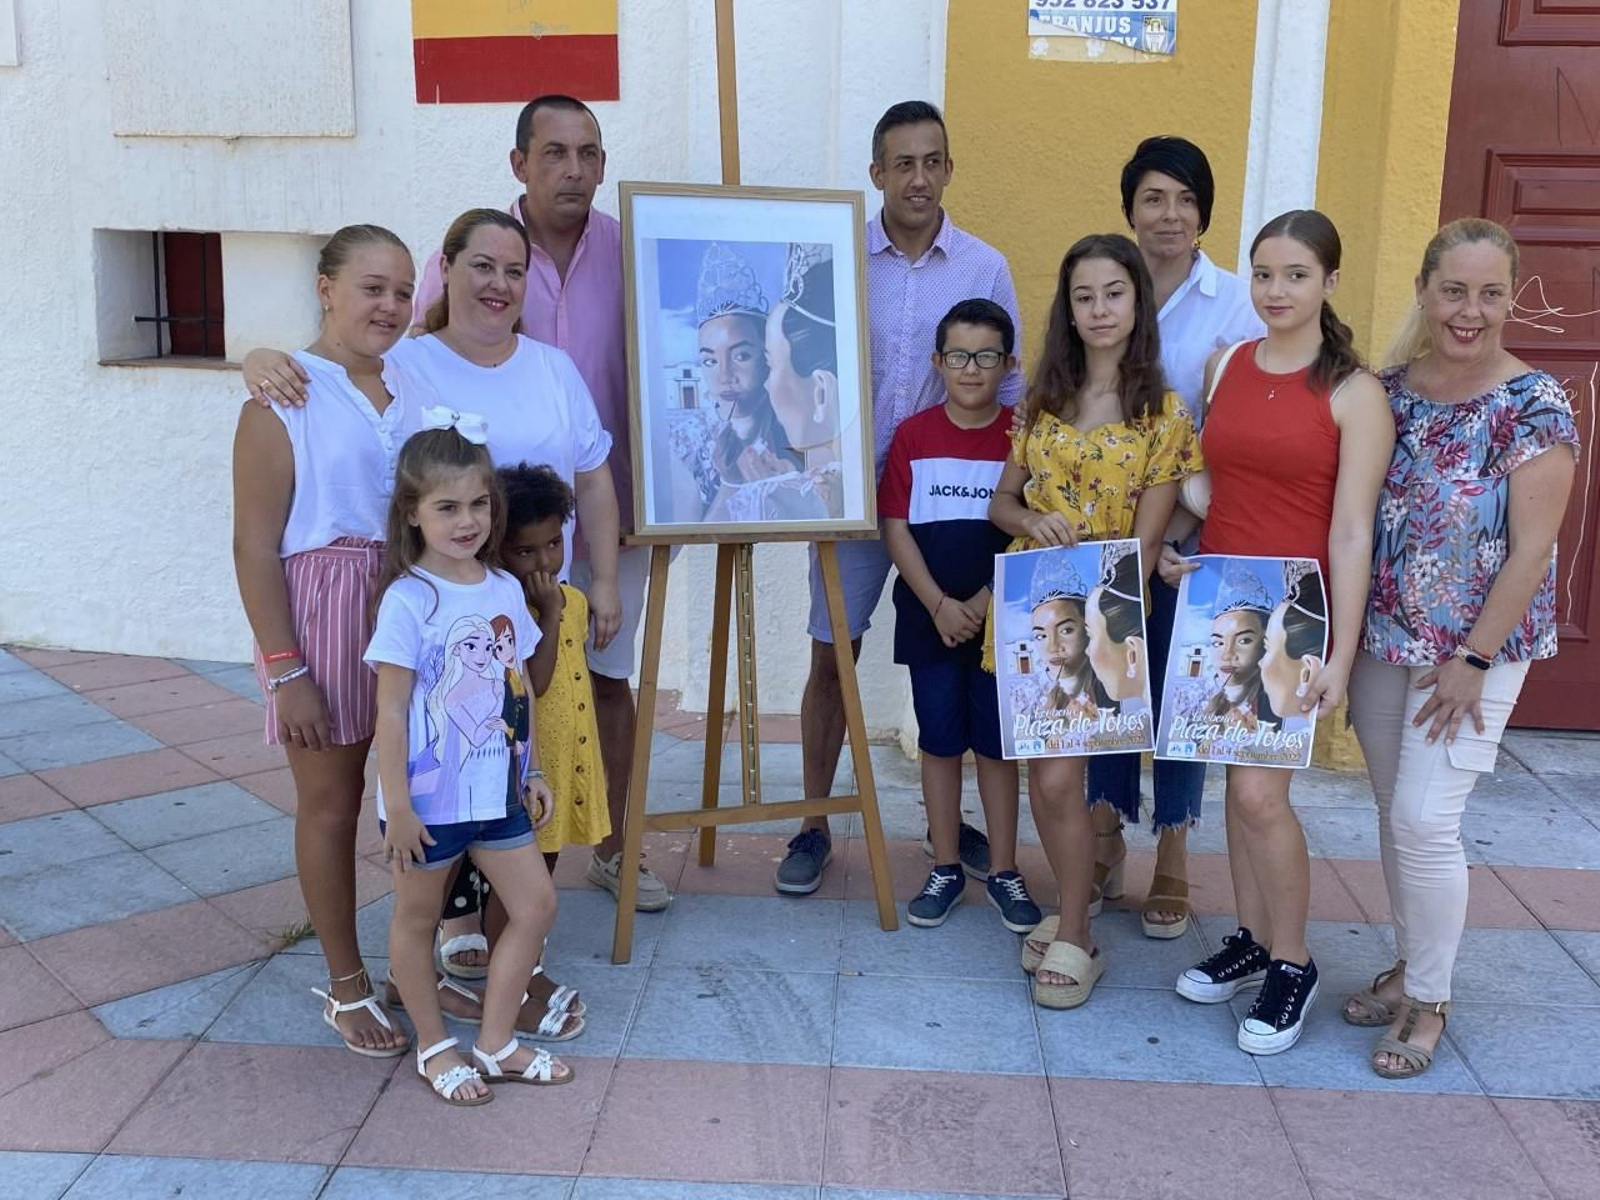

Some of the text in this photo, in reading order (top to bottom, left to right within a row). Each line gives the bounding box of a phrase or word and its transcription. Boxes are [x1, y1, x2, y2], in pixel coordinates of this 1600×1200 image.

[1013, 707, 1147, 739] Plaza de Toros
[1168, 715, 1306, 750] Plaza de Toros
